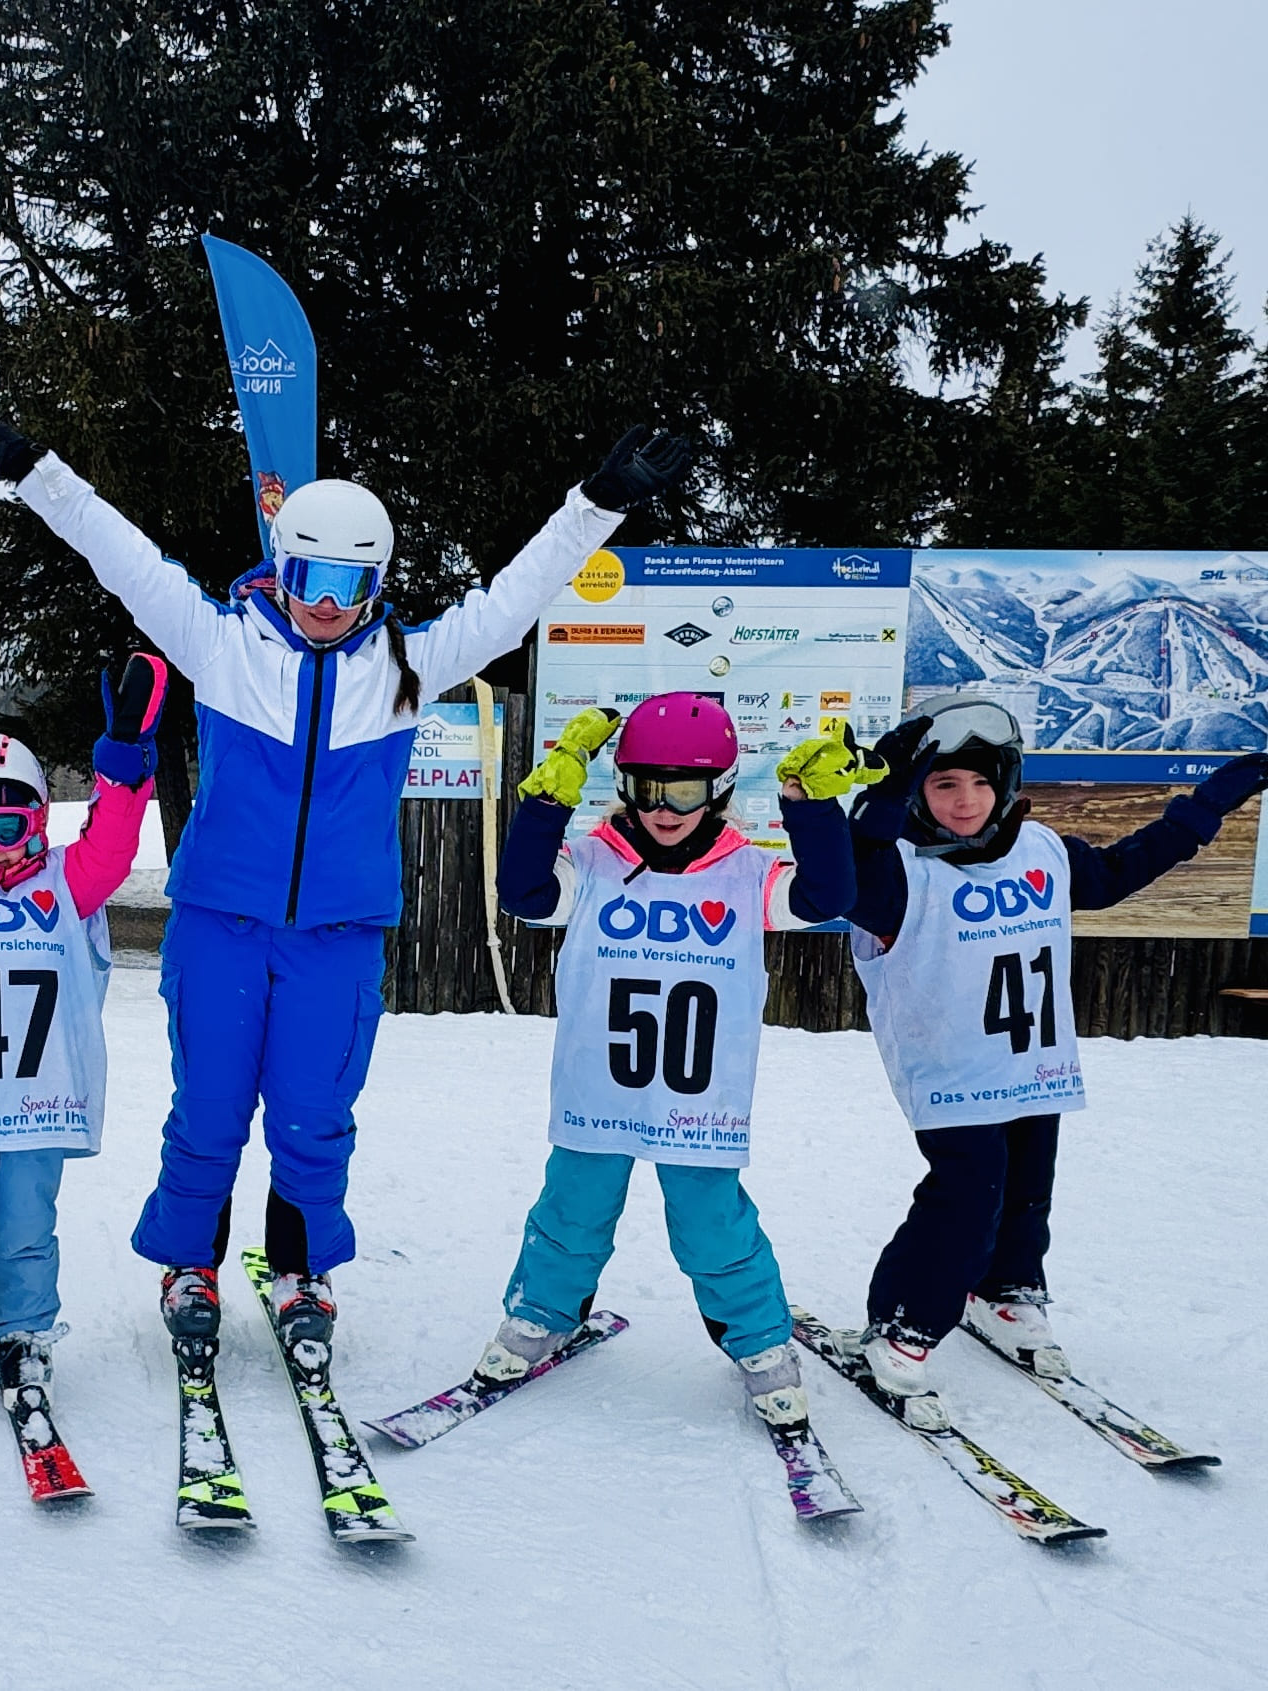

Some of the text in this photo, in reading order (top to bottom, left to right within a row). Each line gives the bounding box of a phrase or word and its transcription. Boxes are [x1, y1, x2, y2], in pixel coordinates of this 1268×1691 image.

[645, 557, 671, 565] Danke
[674, 557, 690, 565] den
[692, 557, 723, 565] Firmen
[734, 625, 800, 641] HOFSTÄTTER
[958, 917, 1062, 942] Meine Versicherung
[597, 946, 736, 970] Meine Versicherung
[983, 945, 1057, 1055] 41
[608, 978, 718, 1095] 50
[1034, 1062, 1066, 1082] Sport
[930, 1091, 965, 1105] Das
[970, 1081, 1041, 1101] versichern
[1046, 1076, 1068, 1091] wir
[20, 1094, 61, 1115] Sport
[35, 1110, 60, 1124] wir
[564, 1110, 586, 1127] Das
[591, 1117, 675, 1139] versichern
[682, 1127, 708, 1141] wir
[667, 1108, 708, 1131] Sport
[711, 1111, 729, 1127] tut
